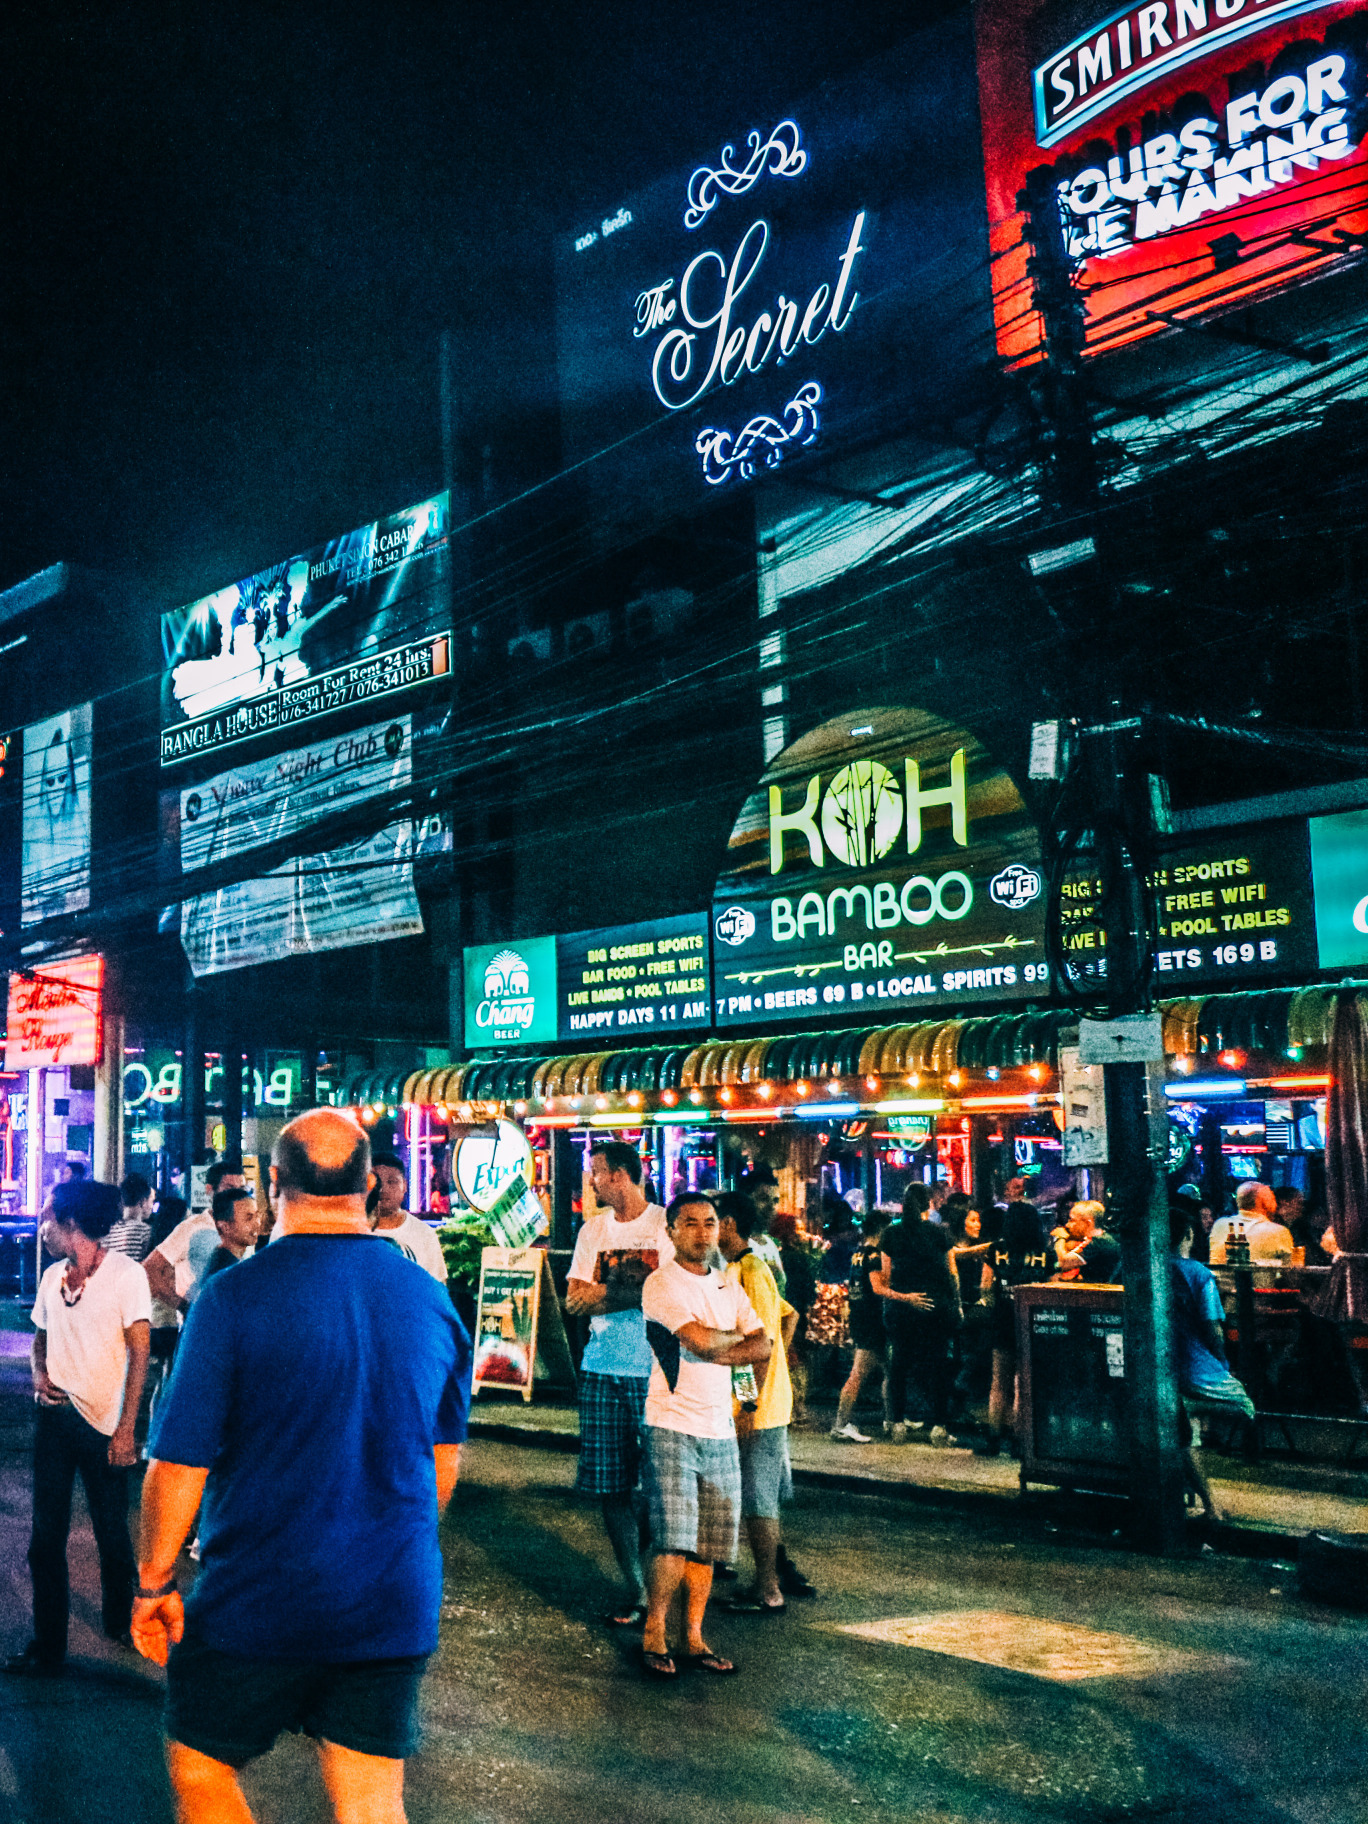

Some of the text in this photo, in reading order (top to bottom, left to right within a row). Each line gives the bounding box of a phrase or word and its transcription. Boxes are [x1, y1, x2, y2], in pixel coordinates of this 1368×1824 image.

[1226, 54, 1350, 148] FOR
[1135, 106, 1358, 240] MAKING
[633, 210, 865, 410] The Secret
[384, 549, 399, 564] 342
[282, 685, 320, 706] Room
[323, 676, 346, 692] For
[349, 661, 381, 682] Rent
[383, 652, 402, 671] 24
[357, 661, 429, 697] 076-341013
[225, 700, 278, 738] HOUSE
[334, 732, 377, 768] Club
[768, 748, 967, 876] KOH
[1174, 857, 1250, 883] SPORTS
[770, 870, 973, 942] BAMBOO
[1165, 882, 1266, 912] FREE WIFI
[1171, 908, 1292, 938] POOL TABLES
[588, 935, 703, 963] BIG SCREEN SPORTS
[843, 940, 894, 971] BAR
[1152, 940, 1278, 973] ETS 169 B
[582, 957, 703, 984] BAR FOOD FREE WIFI
[568, 978, 705, 1006] LIVE BANDS POOL TABLES
[570, 1012, 612, 1030] HAPPY
[617, 1008, 653, 1026] DAYS
[659, 1005, 676, 1021] 11
[716, 999, 725, 1015] 7
[729, 995, 751, 1013] PM
[764, 988, 818, 1009] BEERS
[823, 986, 845, 1003] 69
[851, 982, 863, 1000] B
[877, 976, 936, 998] LOCAL
[942, 967, 1016, 991] SPIRITS
[1023, 963, 1048, 983] 99
[475, 1000, 535, 1029] Chang
[493, 1029, 521, 1040] BEER
[473, 1157, 525, 1195] Export
